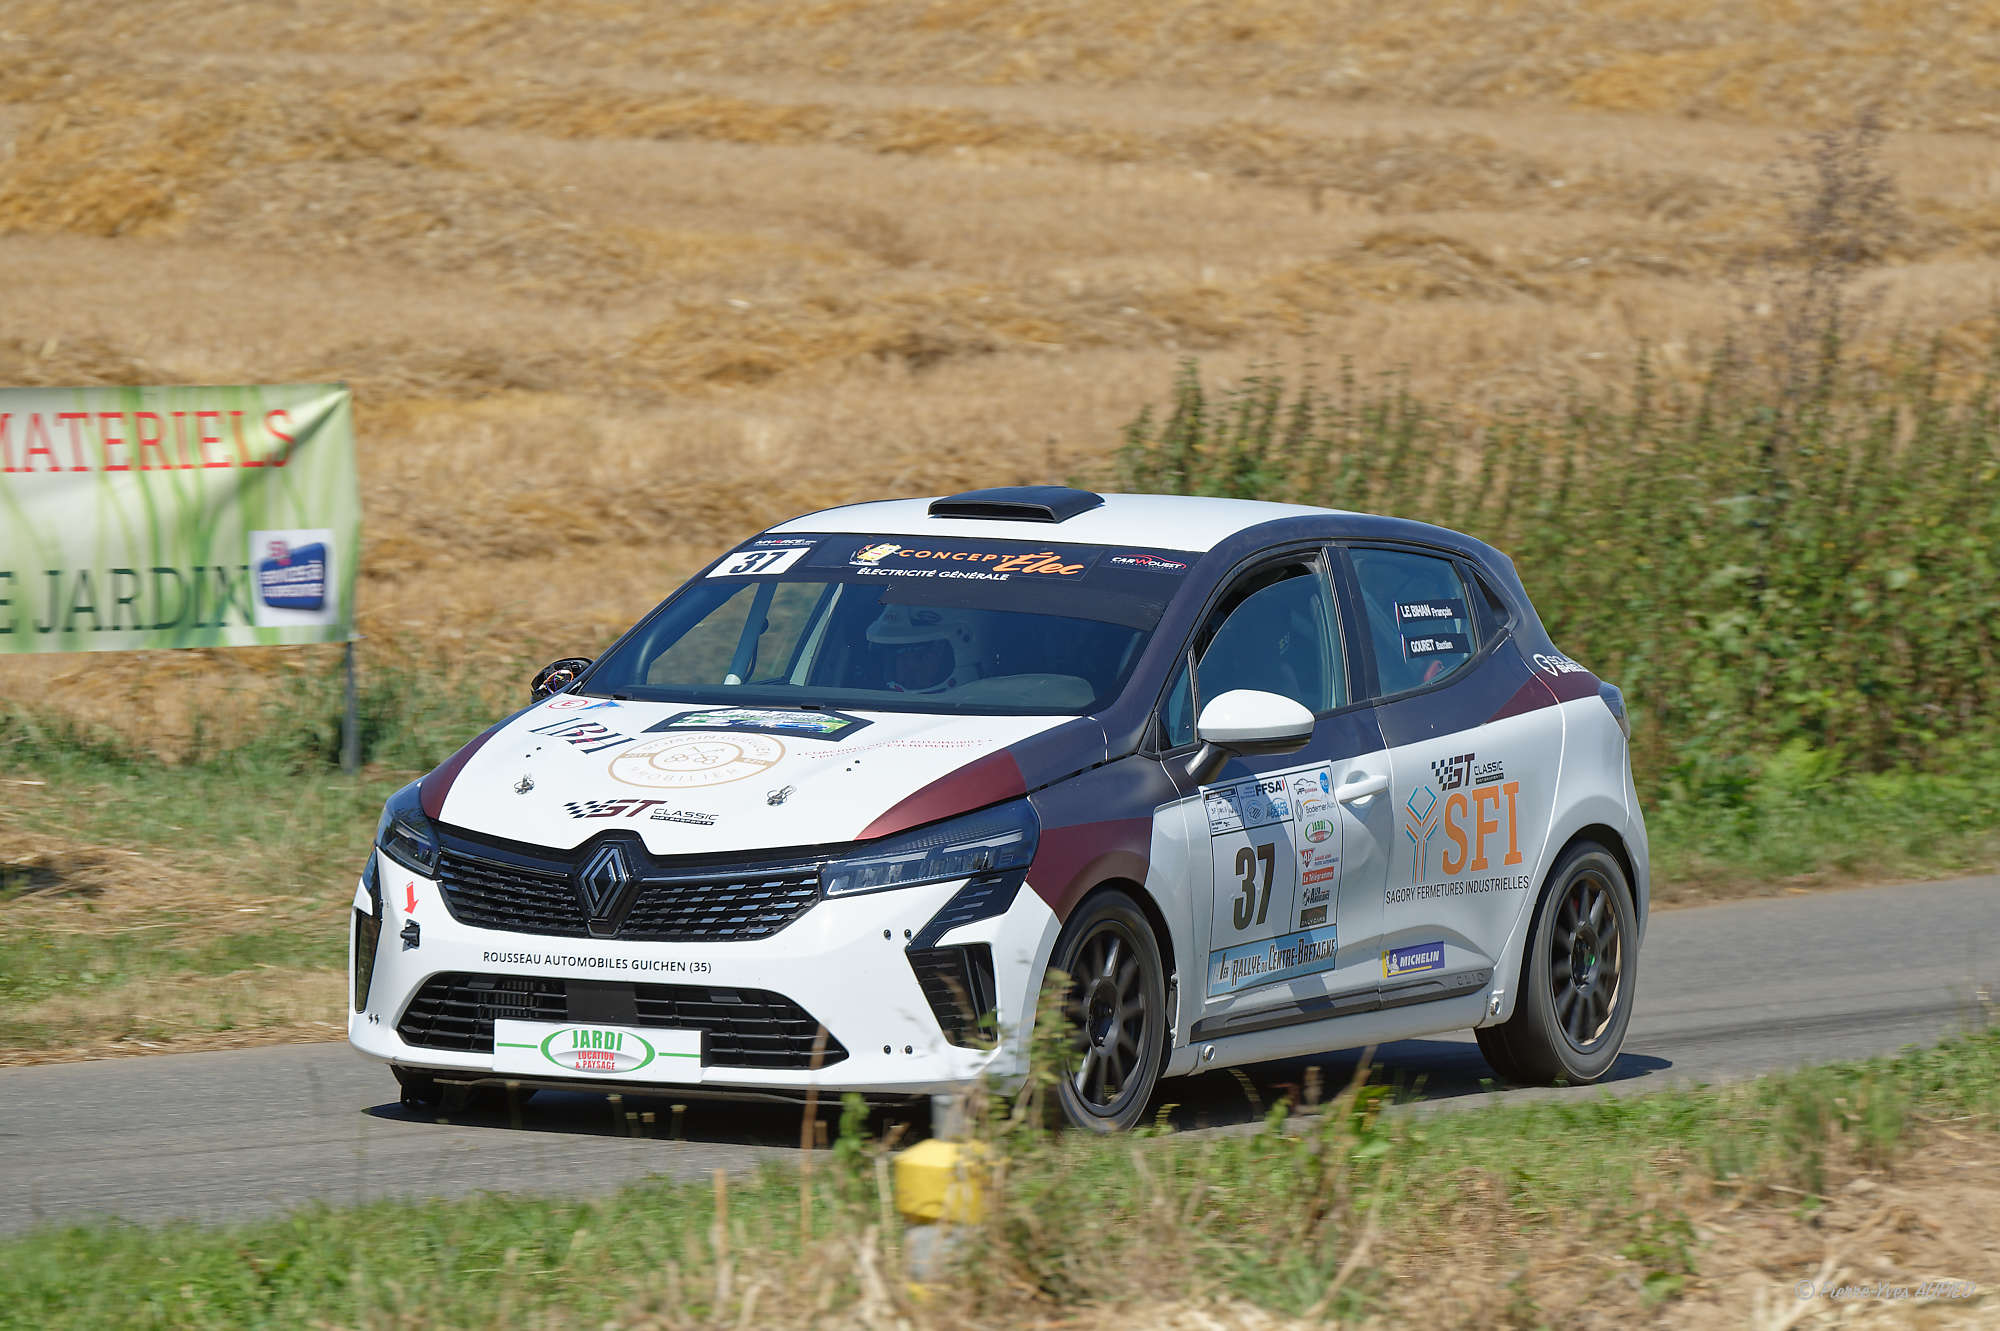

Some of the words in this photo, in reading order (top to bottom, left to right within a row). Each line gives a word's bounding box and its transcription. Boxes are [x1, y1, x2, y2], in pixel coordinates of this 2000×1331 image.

[729, 551, 789, 574] 37
[898, 549, 1015, 563] CONCEPT
[992, 551, 1084, 575] Élec
[857, 567, 936, 578] ÉLECTRICITÉ
[938, 570, 1010, 581] GÉNÉRALE
[32, 565, 252, 633] JARDIN
[1448, 753, 1475, 792] GT
[1474, 760, 1504, 777] CLASSIC
[1255, 779, 1283, 797] FFSA
[584, 799, 668, 819] GT
[653, 808, 719, 821] CLASSIC
[1312, 820, 1326, 832] JARDI
[1442, 781, 1523, 876] SFI
[1233, 842, 1275, 930] 37
[1385, 887, 1415, 905] SAGORY
[1417, 881, 1464, 900] FERMETURES
[1465, 875, 1529, 895] INDUSTRIELLES
[483, 951, 541, 965] ROUSSEAU
[544, 955, 628, 970] AUTOMOBILES
[631, 959, 686, 972] GUICHEN
[689, 961, 712, 974] (35)
[1231, 955, 1262, 987] RALLYE
[1400, 951, 1440, 968] MICHELIN
[572, 1029, 623, 1052] JARDI
[578, 1051, 615, 1061] LOCATION
[583, 1061, 615, 1071] PAYSAGE
